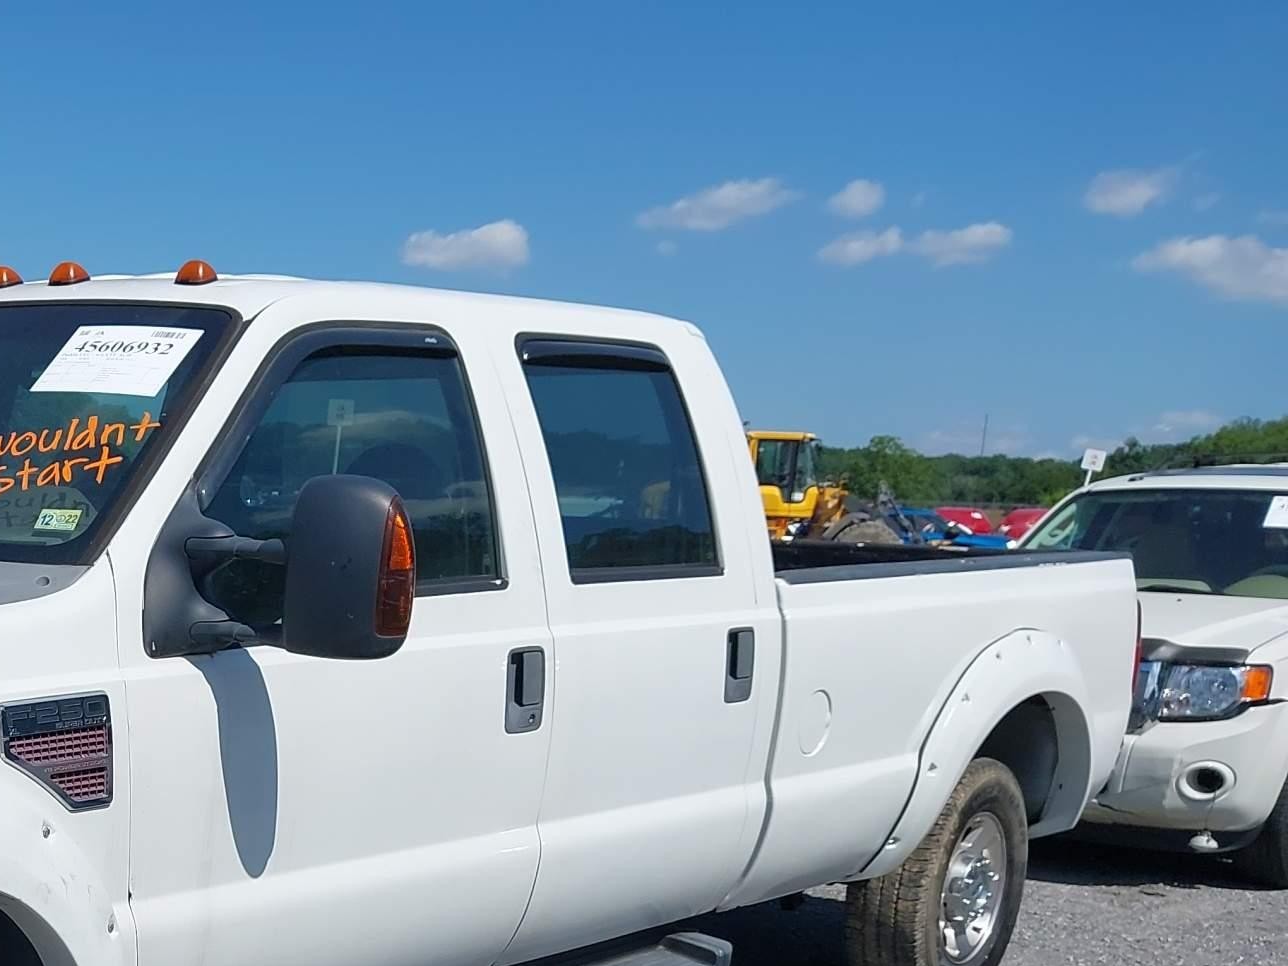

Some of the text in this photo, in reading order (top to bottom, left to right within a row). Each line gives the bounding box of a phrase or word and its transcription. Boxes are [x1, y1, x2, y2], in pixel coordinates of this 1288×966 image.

[74, 340, 175, 356] 45606932
[40, 513, 54, 526] 12
[65, 514, 79, 524] 22
